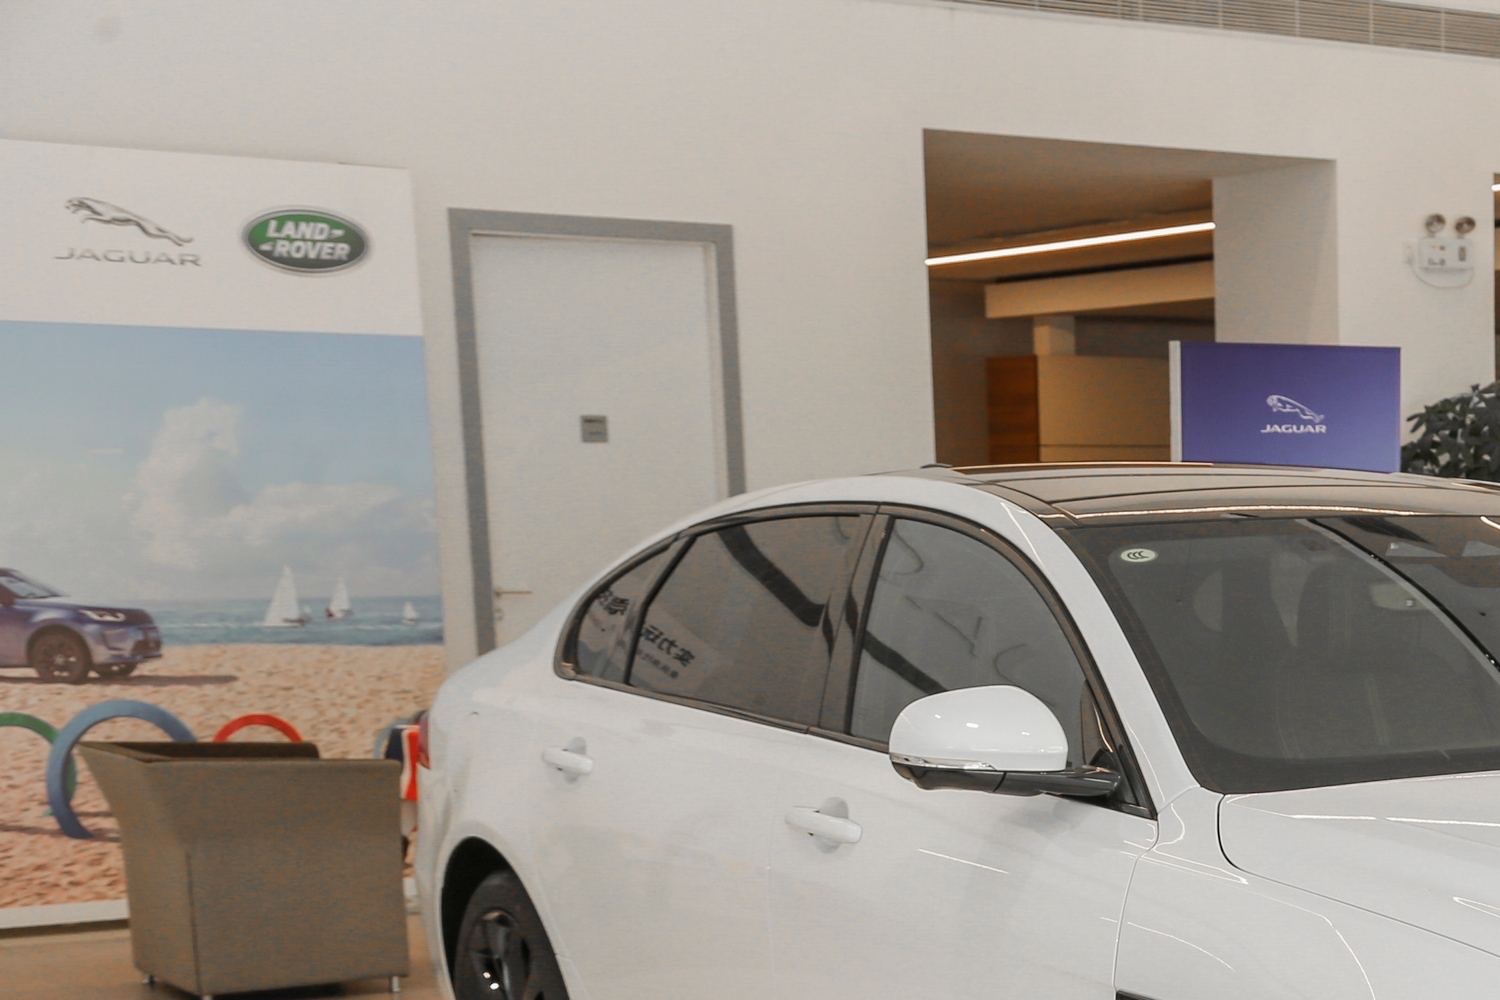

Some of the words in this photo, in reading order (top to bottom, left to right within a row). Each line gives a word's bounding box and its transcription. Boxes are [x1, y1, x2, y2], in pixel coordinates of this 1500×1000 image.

[266, 218, 331, 241] LAND
[53, 246, 204, 268] JAGUAR
[273, 240, 352, 262] ROVER
[1260, 423, 1327, 435] JAGUAR
